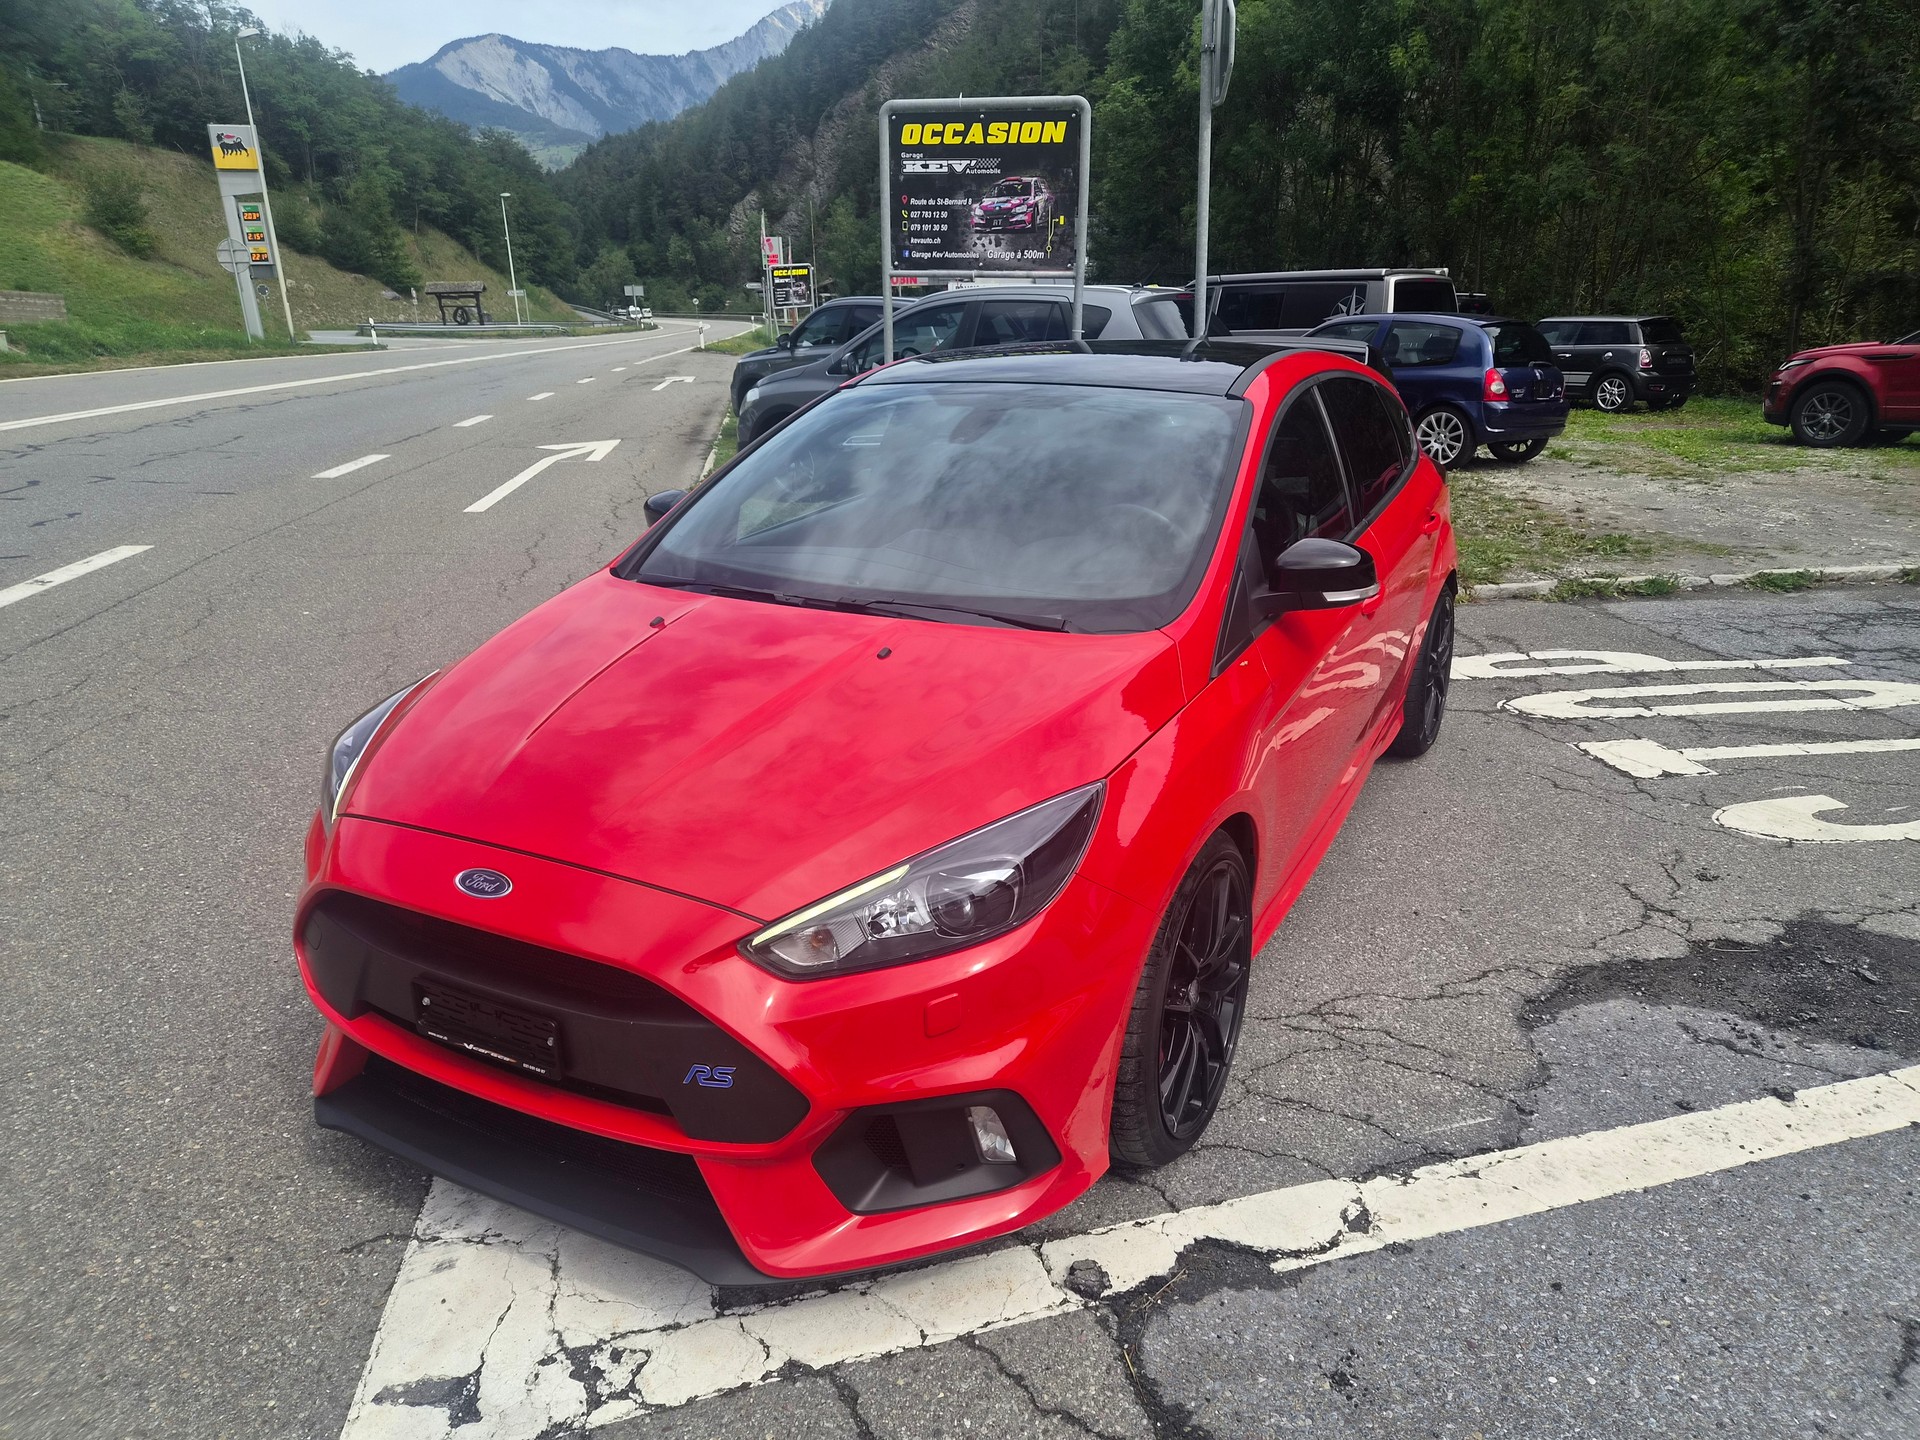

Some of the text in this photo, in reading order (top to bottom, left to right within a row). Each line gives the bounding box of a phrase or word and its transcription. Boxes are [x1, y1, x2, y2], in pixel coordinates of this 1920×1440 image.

[901, 121, 1068, 145] OCCASION
[910, 198, 927, 206] Route
[928, 198, 936, 206] du
[936, 198, 968, 206] St-Bernard
[910, 211, 948, 219] 027 783 12 50
[910, 224, 948, 232] 079 101 30 50
[911, 251, 932, 260] Garage
[987, 249, 1045, 260] Garage à 500m
[464, 873, 501, 893] Ford
[683, 1063, 737, 1088] RS
